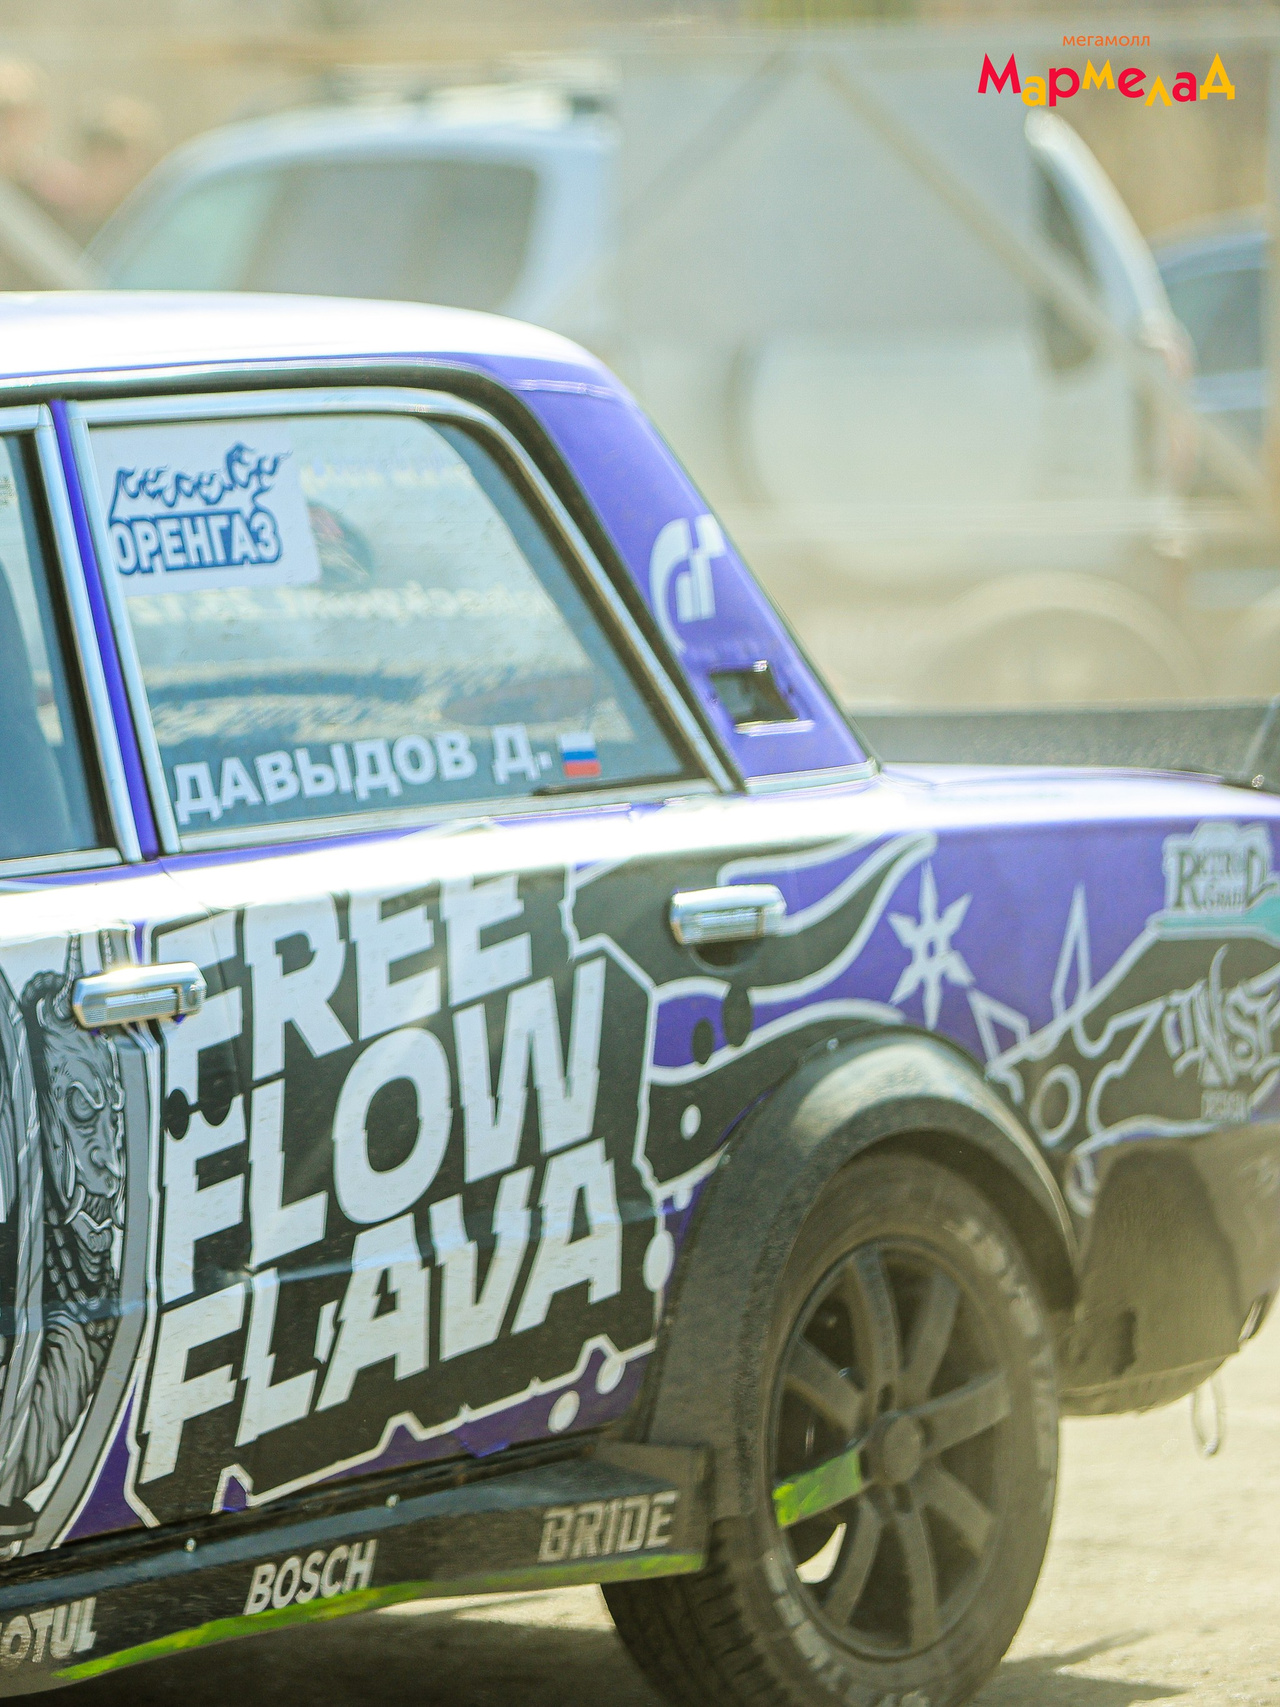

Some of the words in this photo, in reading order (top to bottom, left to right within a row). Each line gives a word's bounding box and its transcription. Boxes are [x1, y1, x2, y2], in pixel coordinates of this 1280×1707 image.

[109, 510, 283, 575] ОРЕНГАЗ
[172, 731, 476, 824] ДАВЫДОВ
[491, 724, 552, 785] Д.
[156, 870, 533, 1107] FREE
[161, 957, 606, 1305] FLOW
[140, 1137, 622, 1485] FLAVA
[243, 1538, 378, 1616] BOSCH
[537, 1490, 680, 1564] BRIDE
